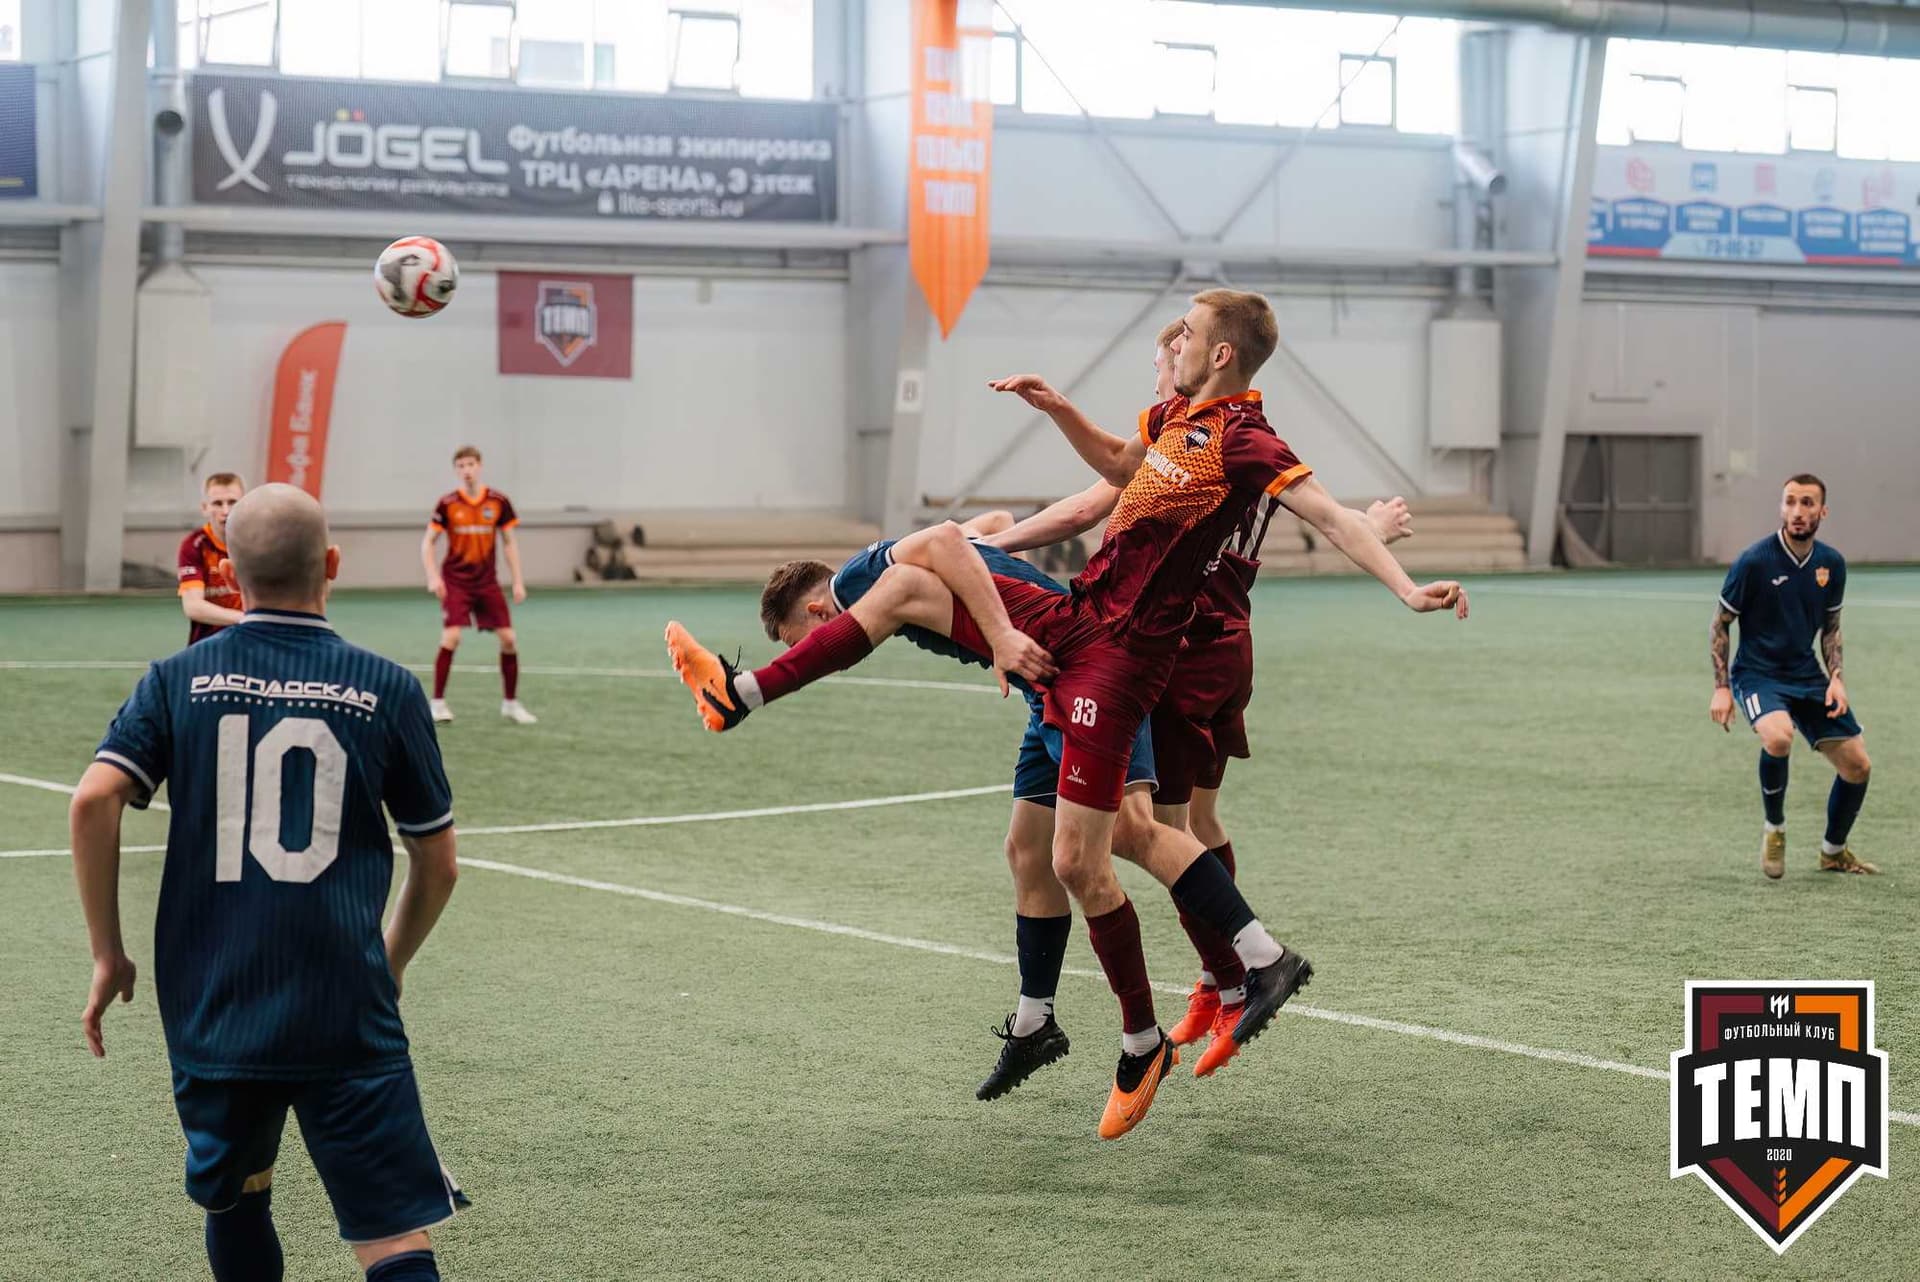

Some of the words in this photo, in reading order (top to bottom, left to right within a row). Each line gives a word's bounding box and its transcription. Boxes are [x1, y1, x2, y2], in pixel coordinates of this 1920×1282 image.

[282, 108, 510, 174] JÖGEL
[508, 124, 673, 158] Футбольная
[677, 136, 832, 167] экипировка
[519, 160, 582, 193] ТРЦ
[585, 163, 725, 197] «АРЕНА»,
[727, 168, 748, 194] 3
[751, 174, 815, 195] этаж
[1071, 696, 1098, 728] 33
[215, 714, 348, 884] 10
